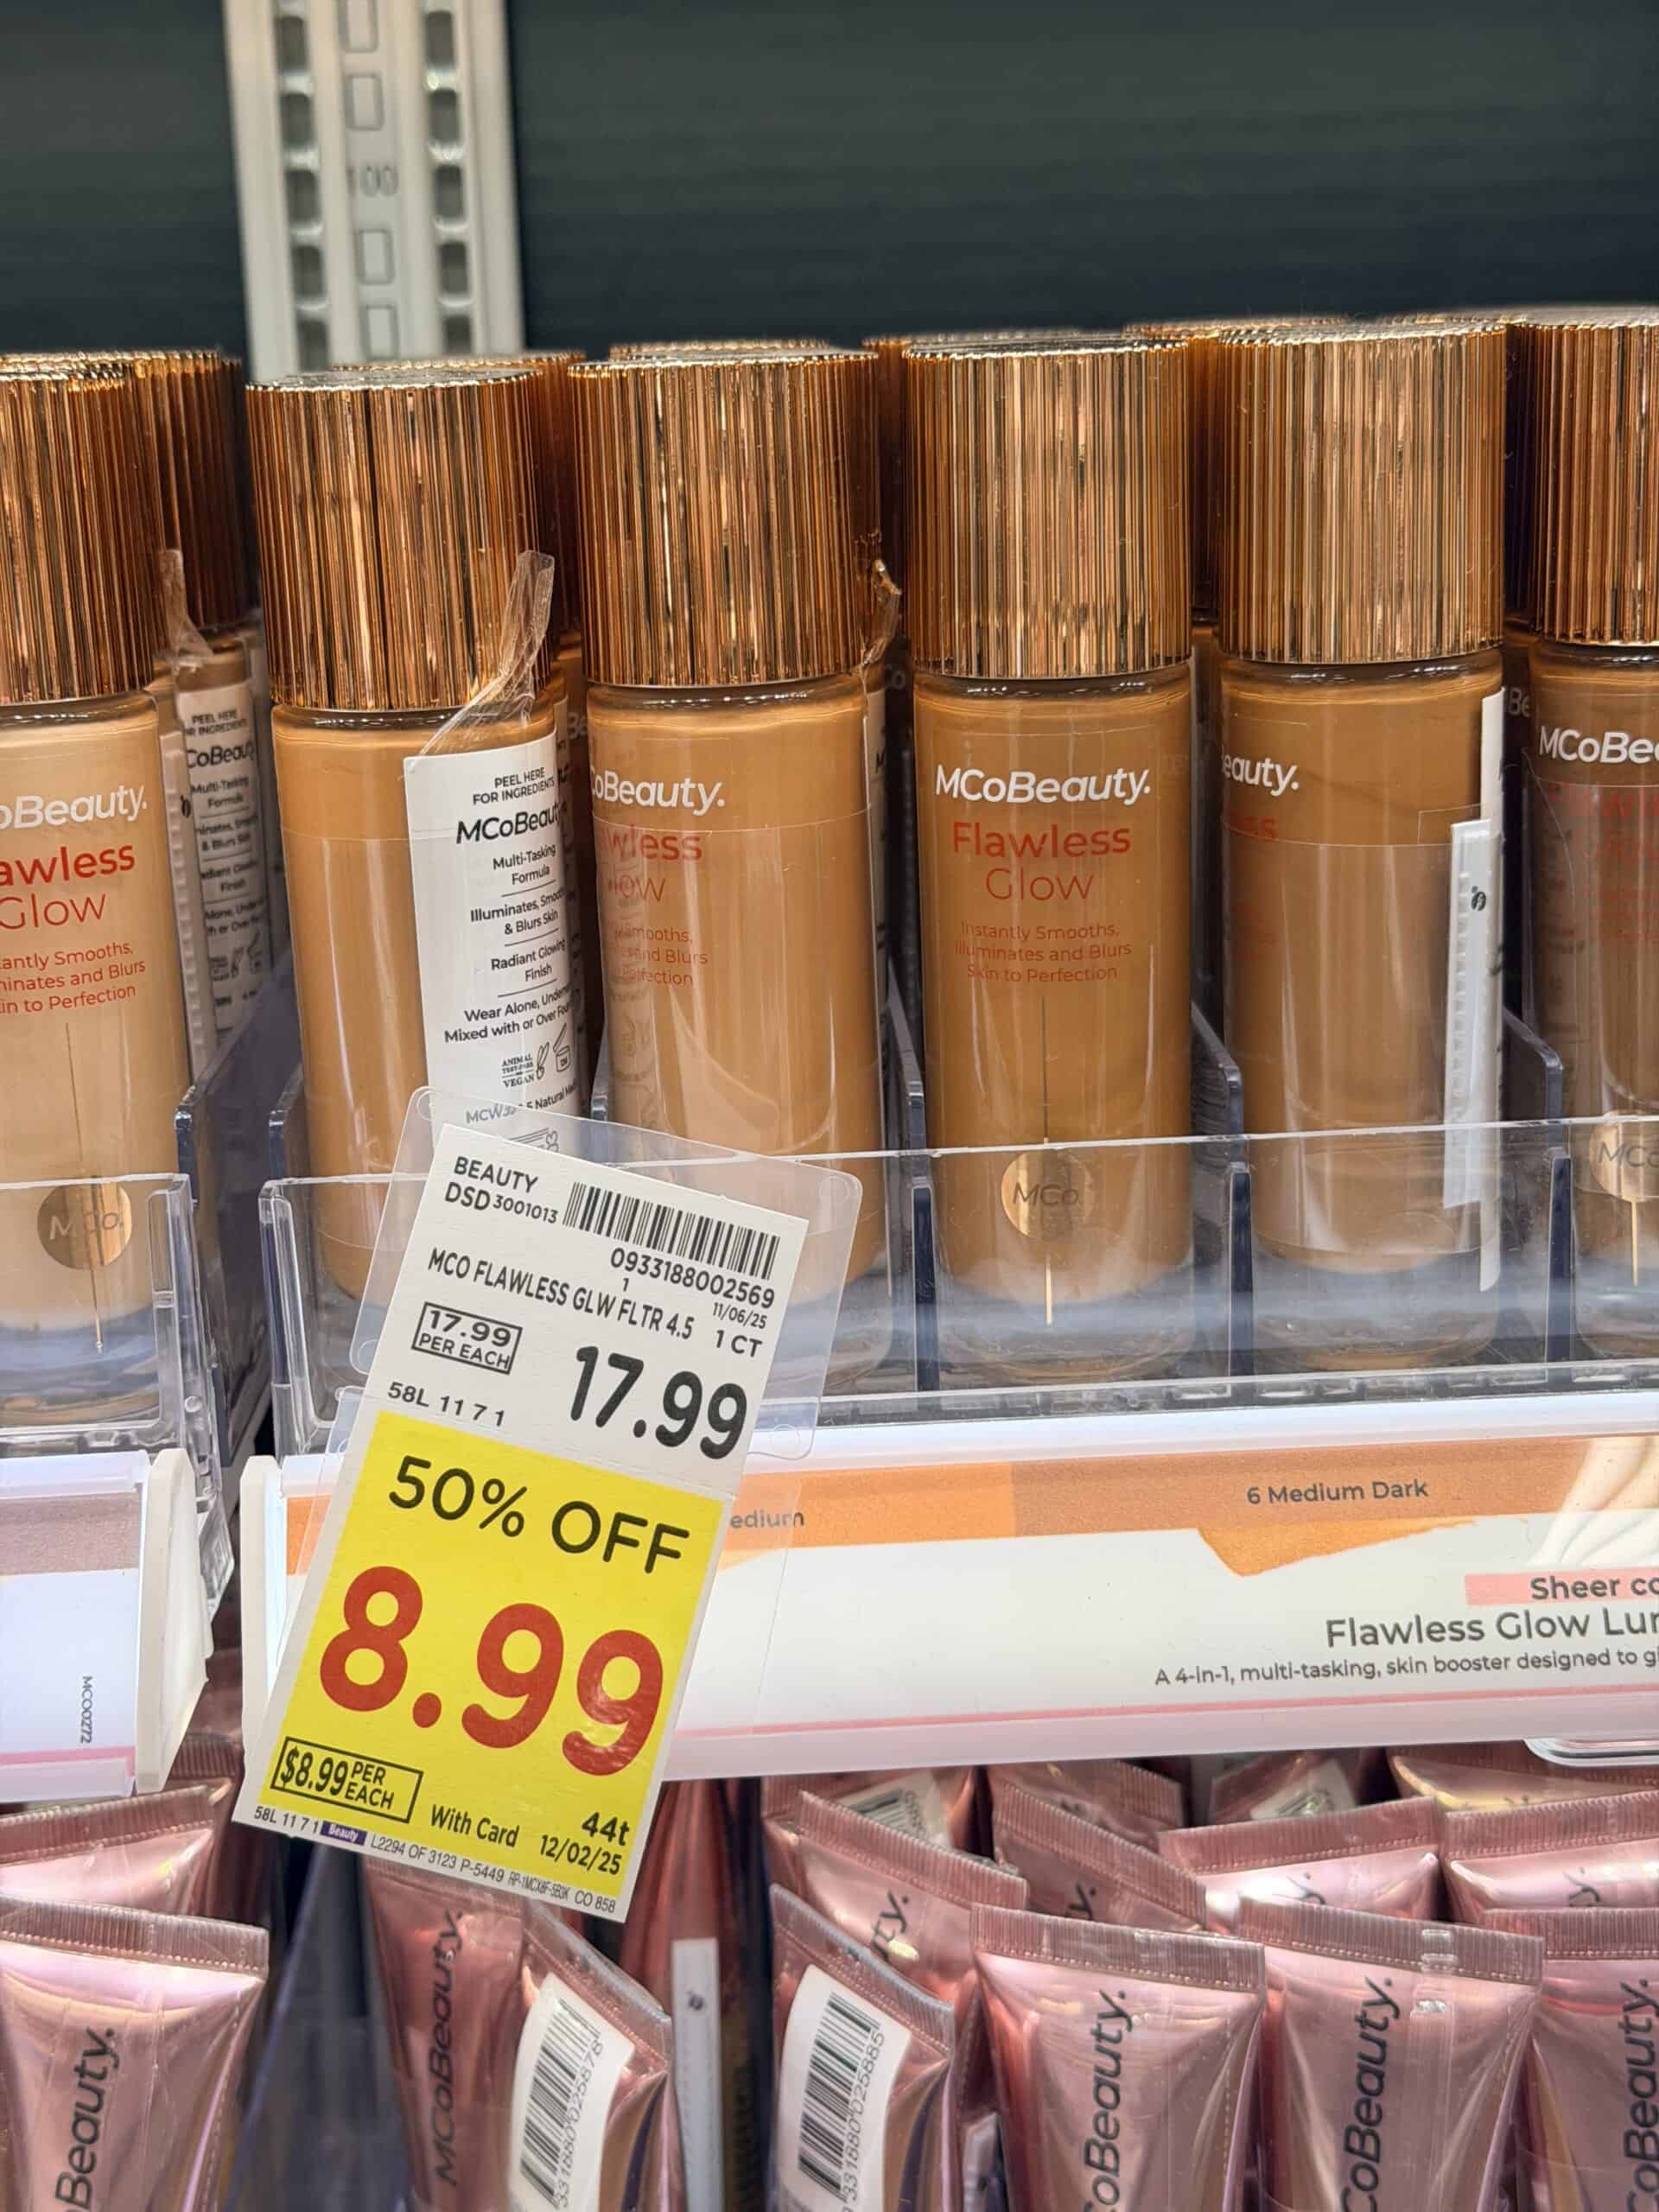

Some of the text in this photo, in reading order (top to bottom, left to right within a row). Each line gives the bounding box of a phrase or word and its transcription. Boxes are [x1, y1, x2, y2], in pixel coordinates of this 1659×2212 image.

[1540, 725, 1659, 765] MCoBe
[473, 776, 555, 805] FOR INGREDIENTS
[494, 766, 545, 788] PEEL HERE
[935, 764, 1151, 805] MCoBeauty.
[1222, 753, 1300, 797] eauty.
[953, 822, 1131, 858] Flawless
[493, 843, 556, 870] Multi-Tasking
[512, 864, 550, 885] Formula
[986, 868, 1095, 901] Glow
[0, 892, 106, 931] Glow
[505, 909, 559, 935] & Blurs Skin
[961, 921, 1121, 942] Instantly Smooths,
[54, 941, 134, 966] Smooths,
[491, 950, 537, 971] Radiant
[955, 939, 1133, 962] Illuminates and Blurs
[70, 968, 104, 984] and
[109, 959, 147, 980] Blurs
[524, 963, 553, 982] Finish
[967, 963, 1118, 983] Skin to Perfection
[23, 997, 43, 1014] to
[48, 983, 137, 1011] Perfection
[464, 1007, 505, 1023] Wear
[505, 998, 540, 1017] Alone,
[444, 1026, 488, 1043] Mixed
[491, 1021, 520, 1039] with
[523, 1018, 534, 1030] or
[536, 1011, 556, 1027] Over
[503, 1073, 535, 1089] VEGAN
[535, 1085, 567, 1109] Natural
[454, 1155, 539, 1193] BEAUTY
[445, 1181, 559, 1224] DSD 3001013
[428, 1247, 695, 1339] MCO FLAWLESS GLW FLTR 4.5
[610, 1247, 776, 1310] 0933188002569
[622, 1277, 630, 1292] 1
[429, 1309, 512, 1349] 17.99
[712, 1301, 768, 1330] 11/06/25
[418, 1332, 512, 1370] PER EACH
[715, 1329, 763, 1357] 1 CT
[387, 1382, 429, 1408] 58L
[474, 1402, 488, 1422] 7
[494, 1408, 505, 1428] 1
[570, 1345, 748, 1460] 17.99
[1247, 1478, 1429, 1505] 6 Medium Dark
[388, 1455, 690, 1574] 50% OFF
[729, 1510, 804, 1529] edium
[1529, 1575, 1620, 1600] Sheer
[1325, 1613, 1485, 1649] Flawless
[1496, 1609, 1590, 1640] Glow
[320, 1565, 664, 1777] 8.99
[1154, 1668, 1171, 1686] A
[1175, 1664, 1235, 1686] 4-in-1,
[1240, 1658, 1382, 1682] multi-tasking,
[1386, 1655, 1428, 1675] skin
[1433, 1654, 1511, 1674] booster
[1516, 1646, 1611, 1672] designed
[1617, 1648, 1638, 1666] to
[281, 1745, 348, 1796] $8.99
[351, 1761, 386, 1786] PER
[345, 1782, 395, 1810] EACH
[430, 1803, 520, 1847] With Card
[582, 1811, 630, 1847] 44t
[254, 1805, 277, 1824] 58L
[300, 1817, 309, 1832] 7
[312, 1821, 320, 1834] 1
[371, 1835, 406, 1856] L2294
[408, 1845, 427, 1861] OF
[429, 1850, 456, 1869] 3123
[460, 1859, 505, 1883] P-5449
[575, 1890, 593, 1907] CO
[594, 1894, 617, 1914] 858
[540, 1834, 623, 1876] 12/02/25
[1084, 1989, 1134, 2212] oBeauty.
[54, 2025, 120, 2212] Beauty.
